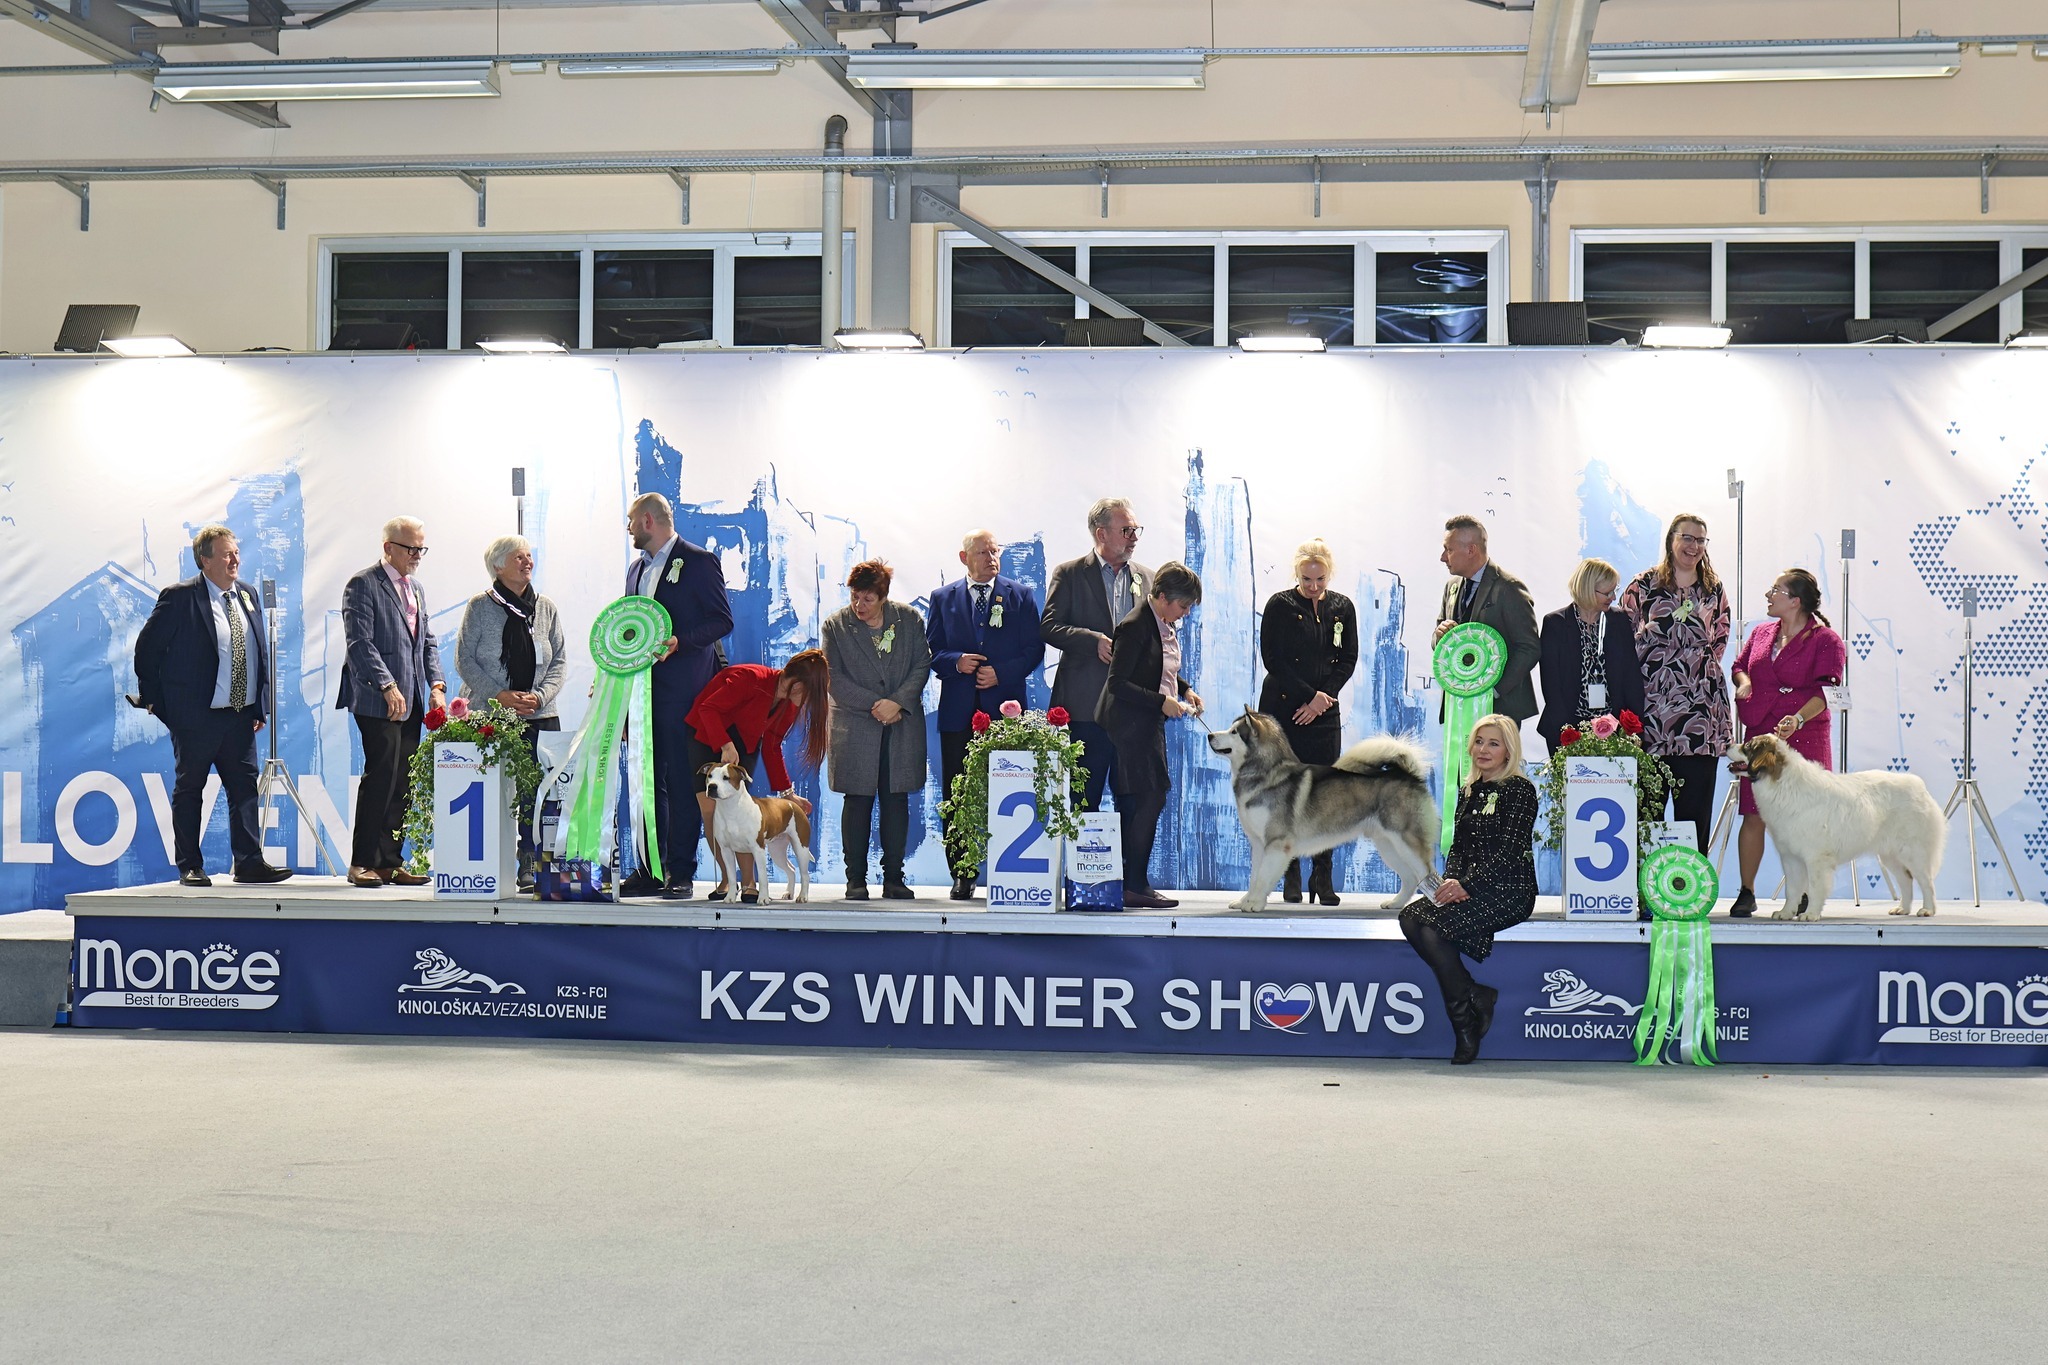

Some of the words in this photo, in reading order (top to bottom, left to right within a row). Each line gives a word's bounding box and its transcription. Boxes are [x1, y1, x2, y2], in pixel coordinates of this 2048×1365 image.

[603, 722, 615, 744] BEST
[601, 745, 609, 755] IN
[449, 781, 484, 861] 1
[995, 791, 1049, 873] 2
[1574, 797, 1630, 882] 3
[124, 992, 155, 1007] Best
[157, 993, 175, 1007] for
[178, 993, 240, 1008] Breeders
[556, 985, 580, 998] KZS
[588, 986, 608, 999] FCI
[700, 969, 832, 1025] KZS
[854, 973, 1138, 1030] WINNER
[1730, 1007, 1750, 1019] FCI
[1929, 1026, 1964, 1042] Best
[1966, 1026, 1986, 1043] for
